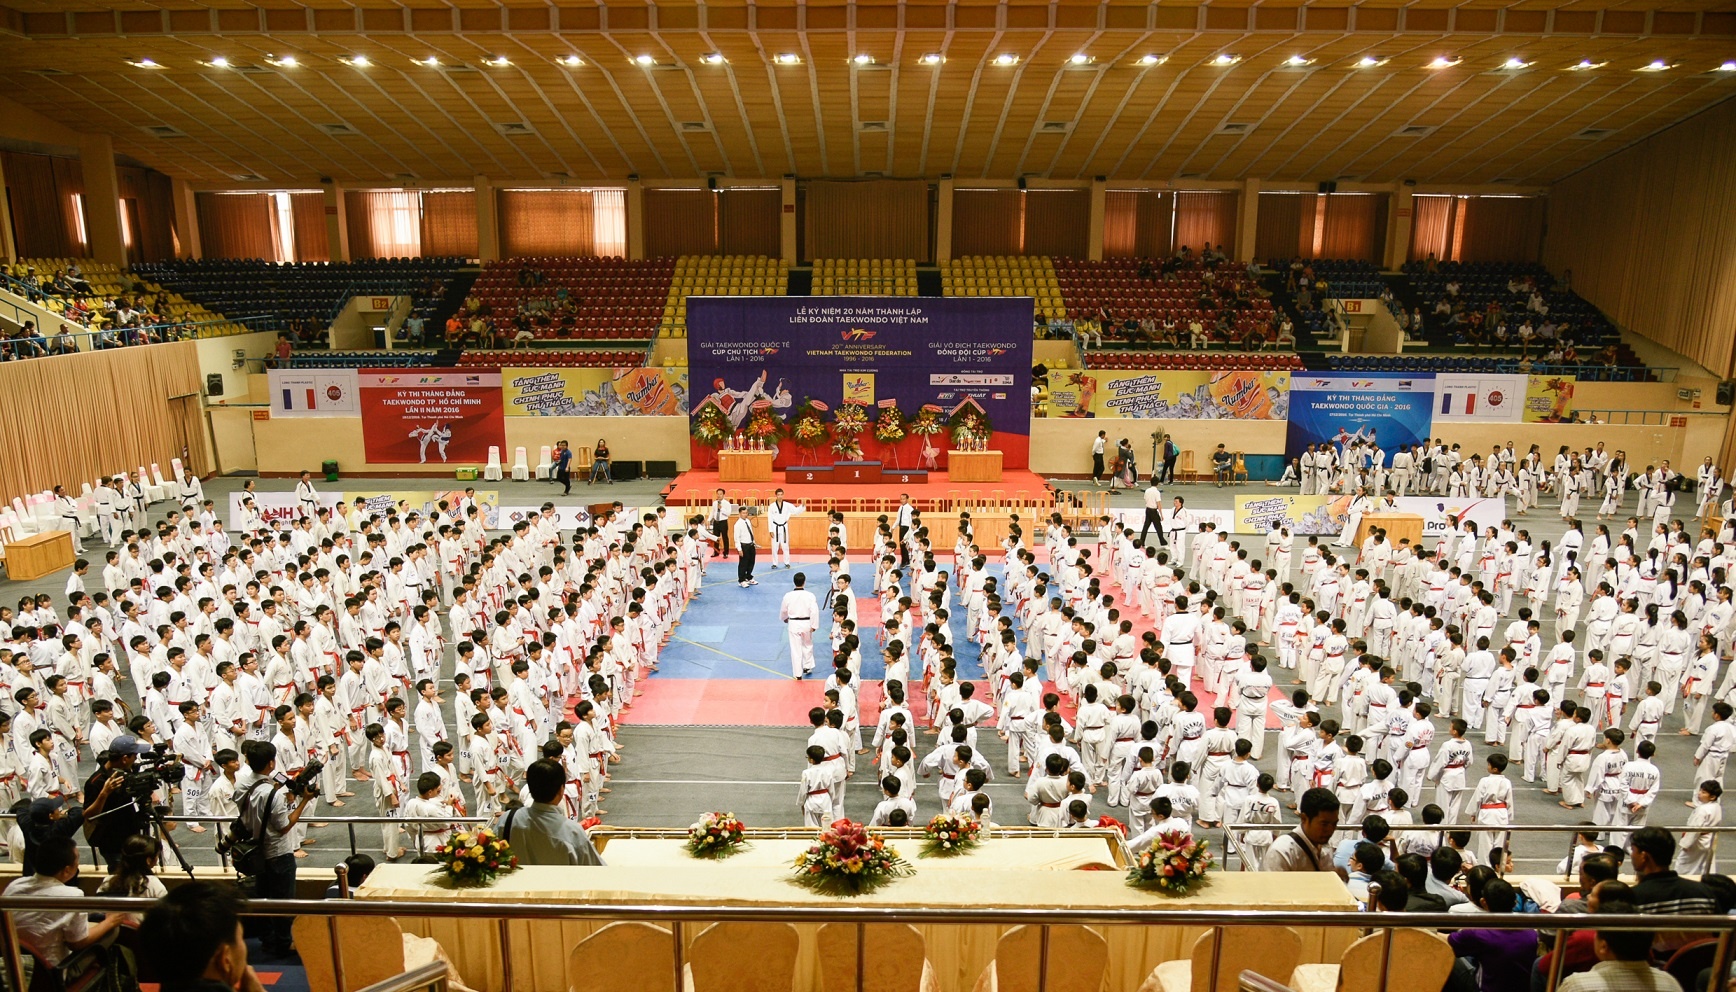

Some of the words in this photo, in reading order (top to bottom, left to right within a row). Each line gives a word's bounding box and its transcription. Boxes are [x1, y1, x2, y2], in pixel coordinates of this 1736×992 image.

[374, 300, 387, 308] B2
[1346, 302, 1360, 311] B1
[797, 306, 806, 314] LỄ
[822, 307, 840, 316] NIỆM
[876, 306, 904, 314] THÀNH
[890, 316, 908, 324] VIỆT
[536, 373, 559, 382] THÊM
[1132, 376, 1156, 386] THÊM
[627, 374, 658, 402] Number
[1222, 377, 1256, 406] Number
